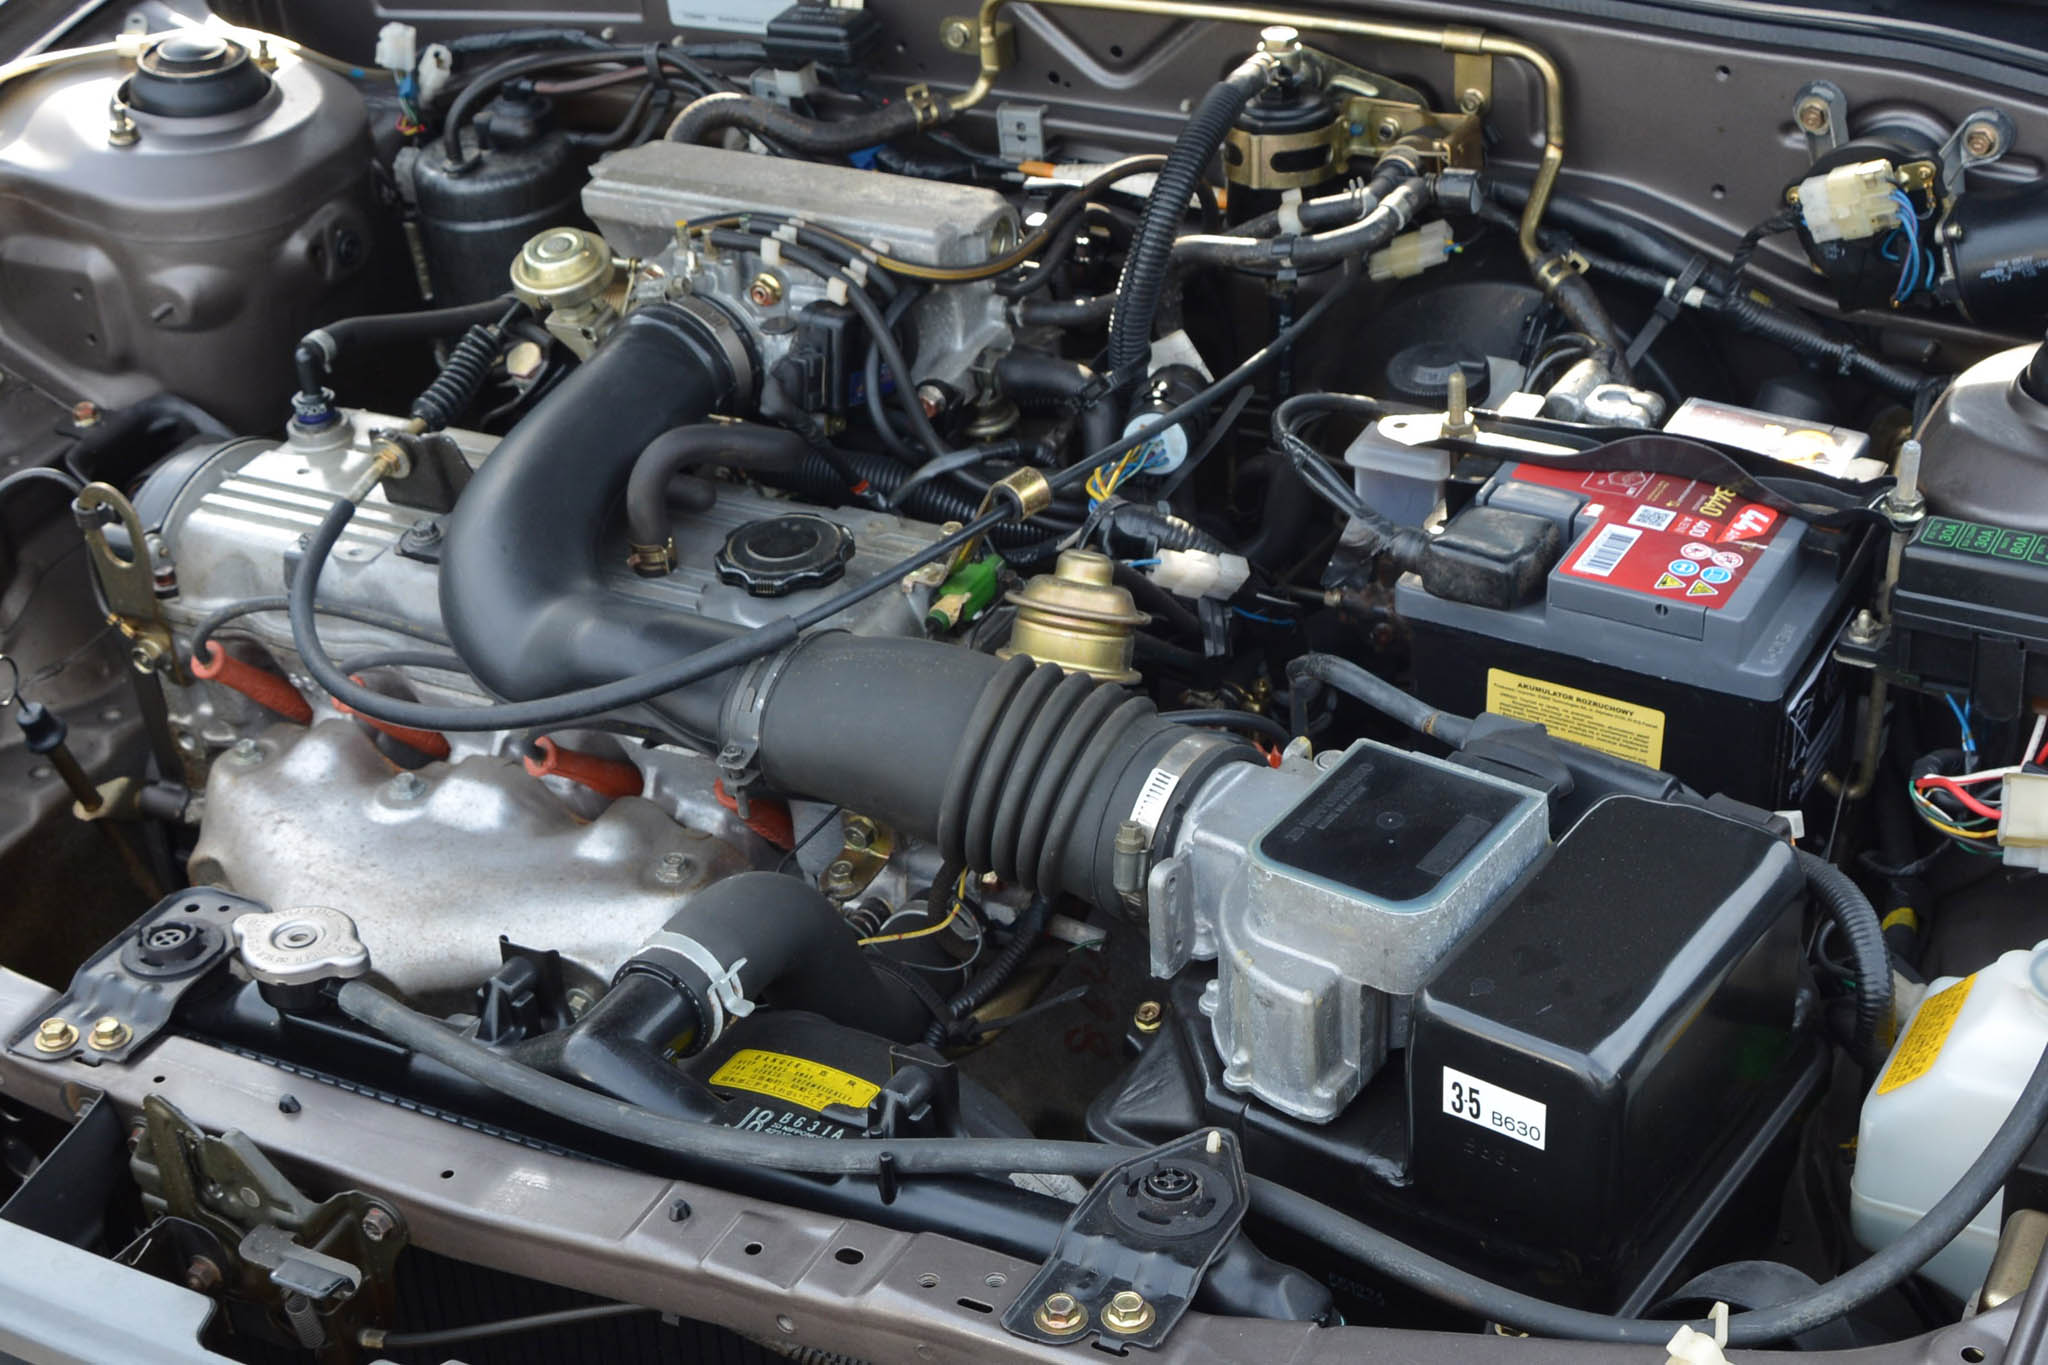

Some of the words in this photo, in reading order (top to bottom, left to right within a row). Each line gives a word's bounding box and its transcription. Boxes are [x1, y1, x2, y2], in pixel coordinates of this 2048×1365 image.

[1689, 520, 1712, 538] 400
[1734, 509, 1770, 534] 44
[1939, 524, 1960, 542] 30A
[2010, 537, 2031, 554] 80A
[1517, 682, 1574, 702] AKUMULATOR
[1576, 697, 1635, 717] ROZRUCHOWY
[754, 1055, 801, 1069] DANGER
[780, 1111, 845, 1140] B631A
[1492, 1111, 1541, 1142] B630
